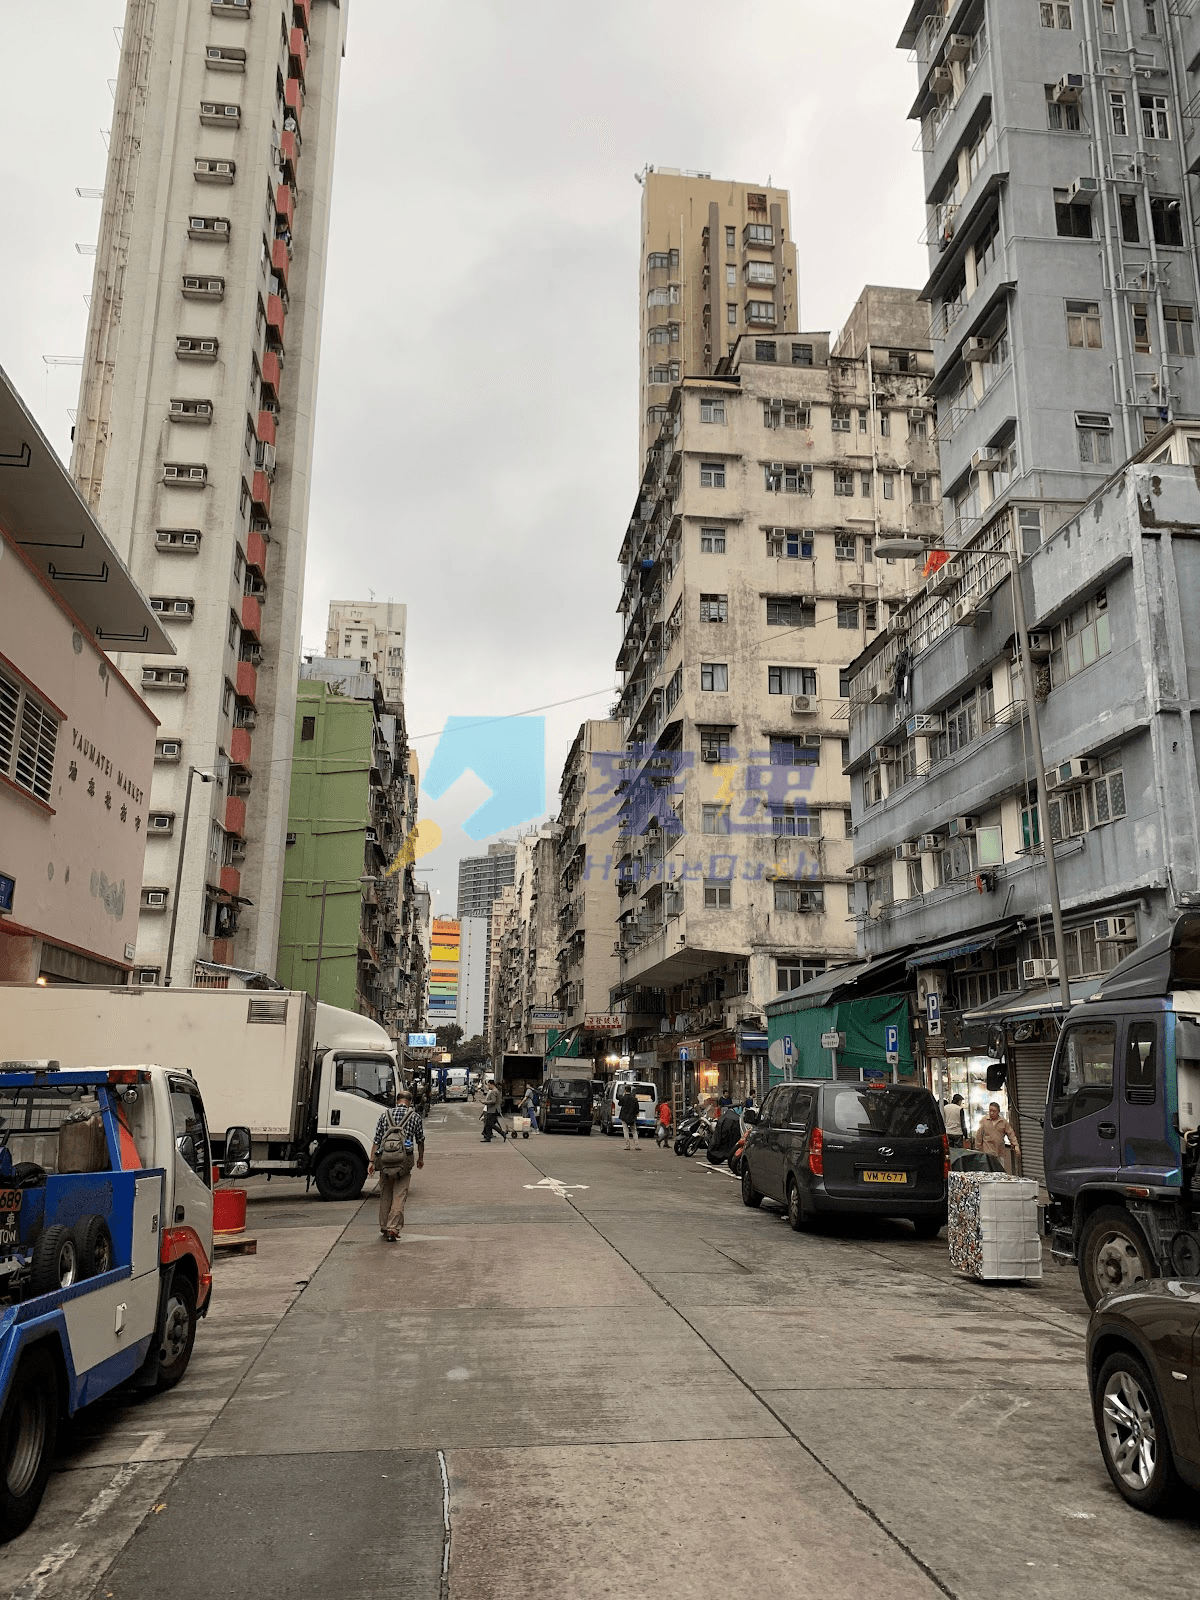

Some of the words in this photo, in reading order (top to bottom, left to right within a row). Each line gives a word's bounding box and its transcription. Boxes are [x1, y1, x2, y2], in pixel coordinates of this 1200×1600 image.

[73, 728, 113, 778] YAUMATEI
[117, 770, 143, 805] MARKET
[928, 995, 937, 1019] P
[888, 1029, 897, 1050] P
[866, 1172, 879, 1181] VM
[880, 1173, 904, 1181] 7677
[5, 1211, 16, 1229] 車
[0, 1229, 17, 1244] TOW
